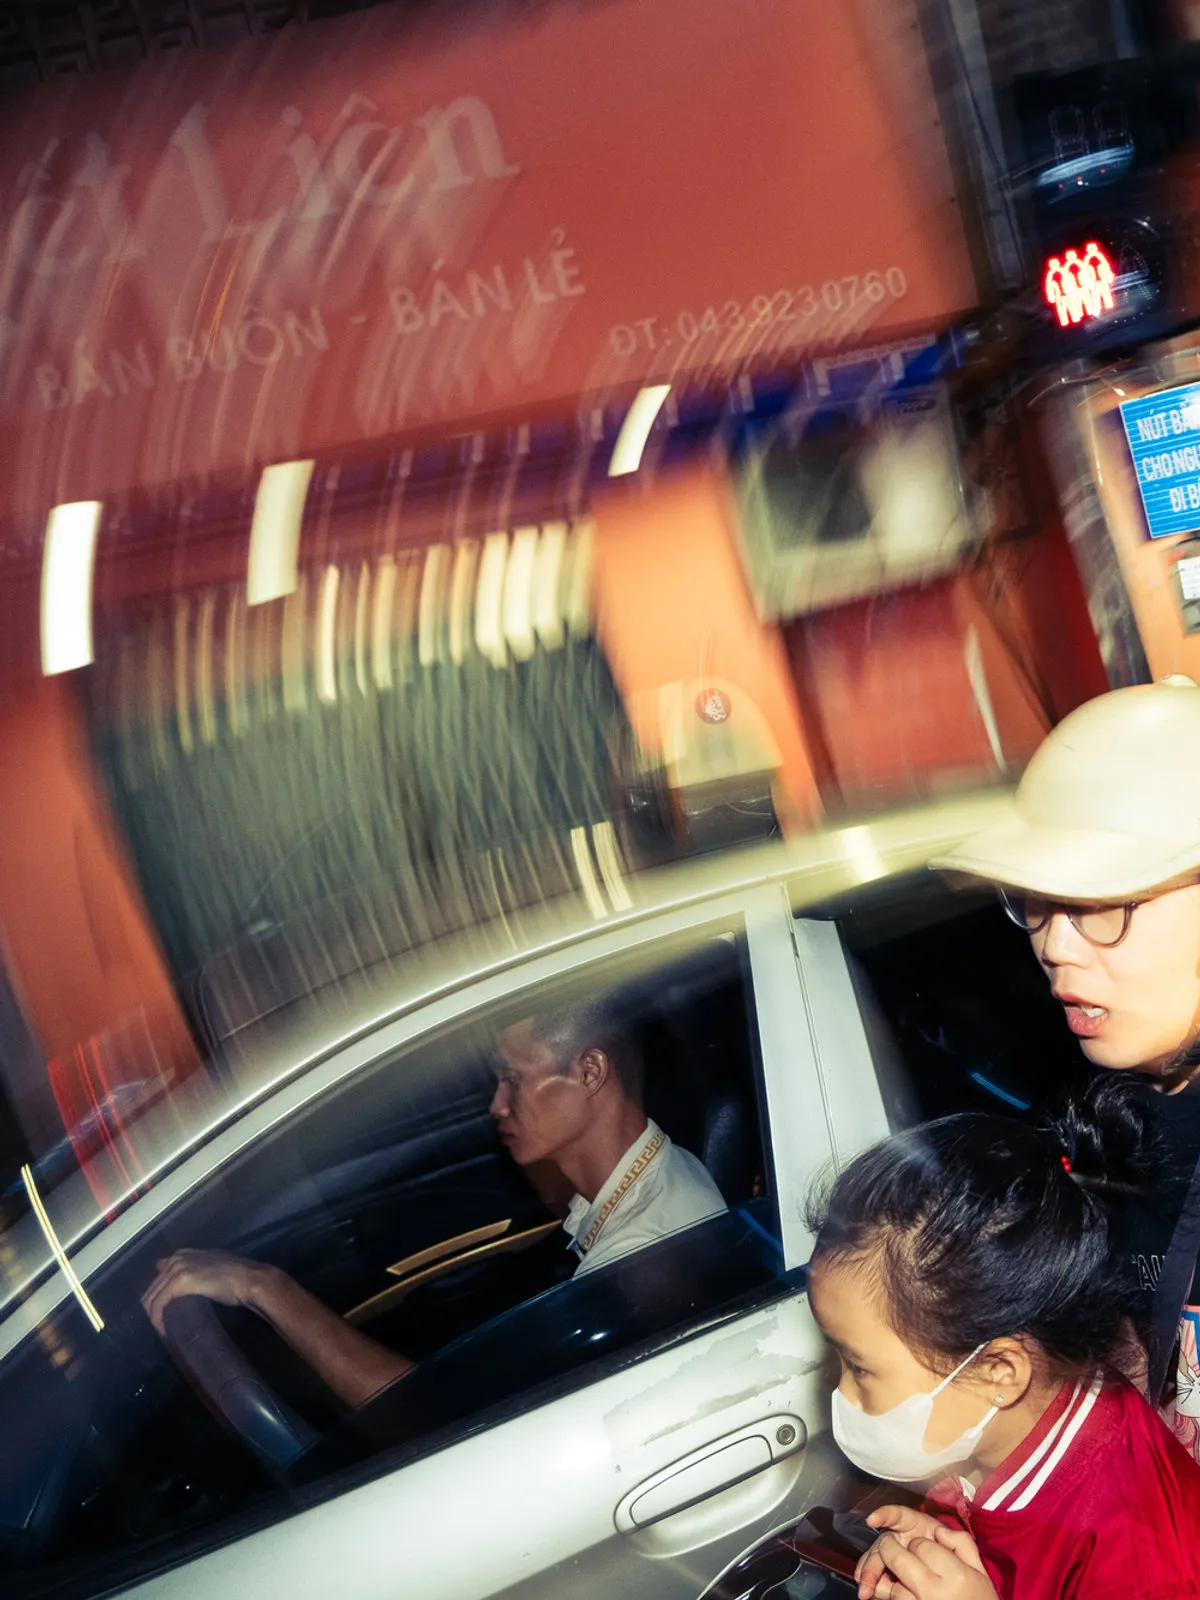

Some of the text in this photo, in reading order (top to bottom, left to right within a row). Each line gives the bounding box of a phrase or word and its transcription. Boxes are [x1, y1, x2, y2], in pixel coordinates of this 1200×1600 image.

[388, 258, 513, 334] BÁN
[1136, 409, 1169, 442] NÚT
[1142, 452, 1173, 481] CHO
[1169, 486, 1187, 512] ĐI
